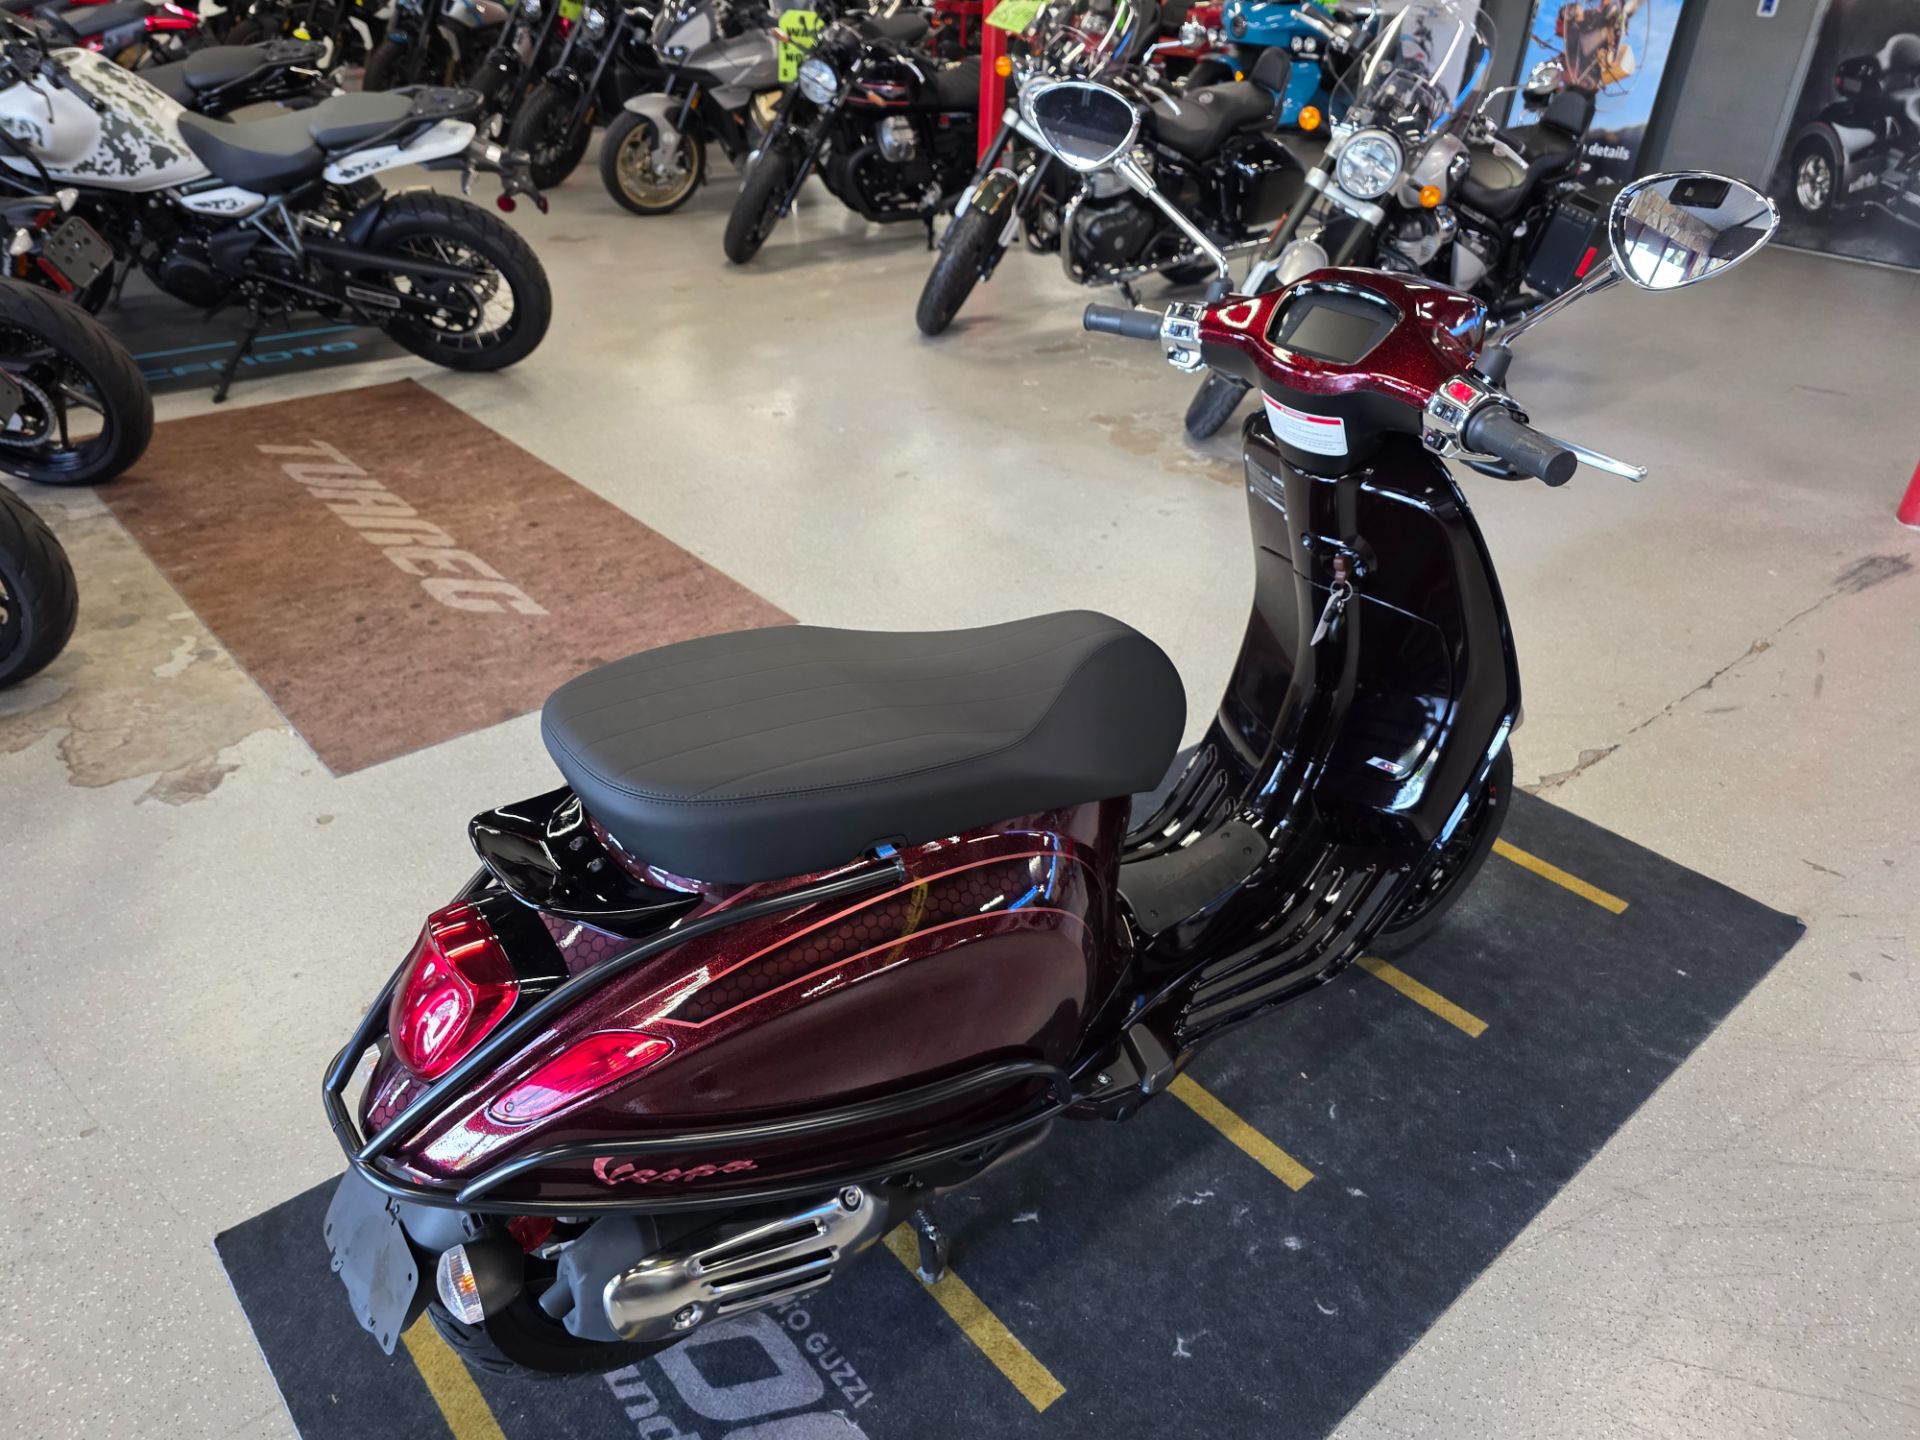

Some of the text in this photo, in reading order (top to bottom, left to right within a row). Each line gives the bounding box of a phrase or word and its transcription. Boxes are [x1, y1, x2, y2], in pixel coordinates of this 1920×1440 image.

[1588, 142, 1630, 161] details
[255, 438, 550, 615] TUAREG
[592, 1155, 759, 1186] Vespa
[806, 1332, 875, 1409] GUZZI
